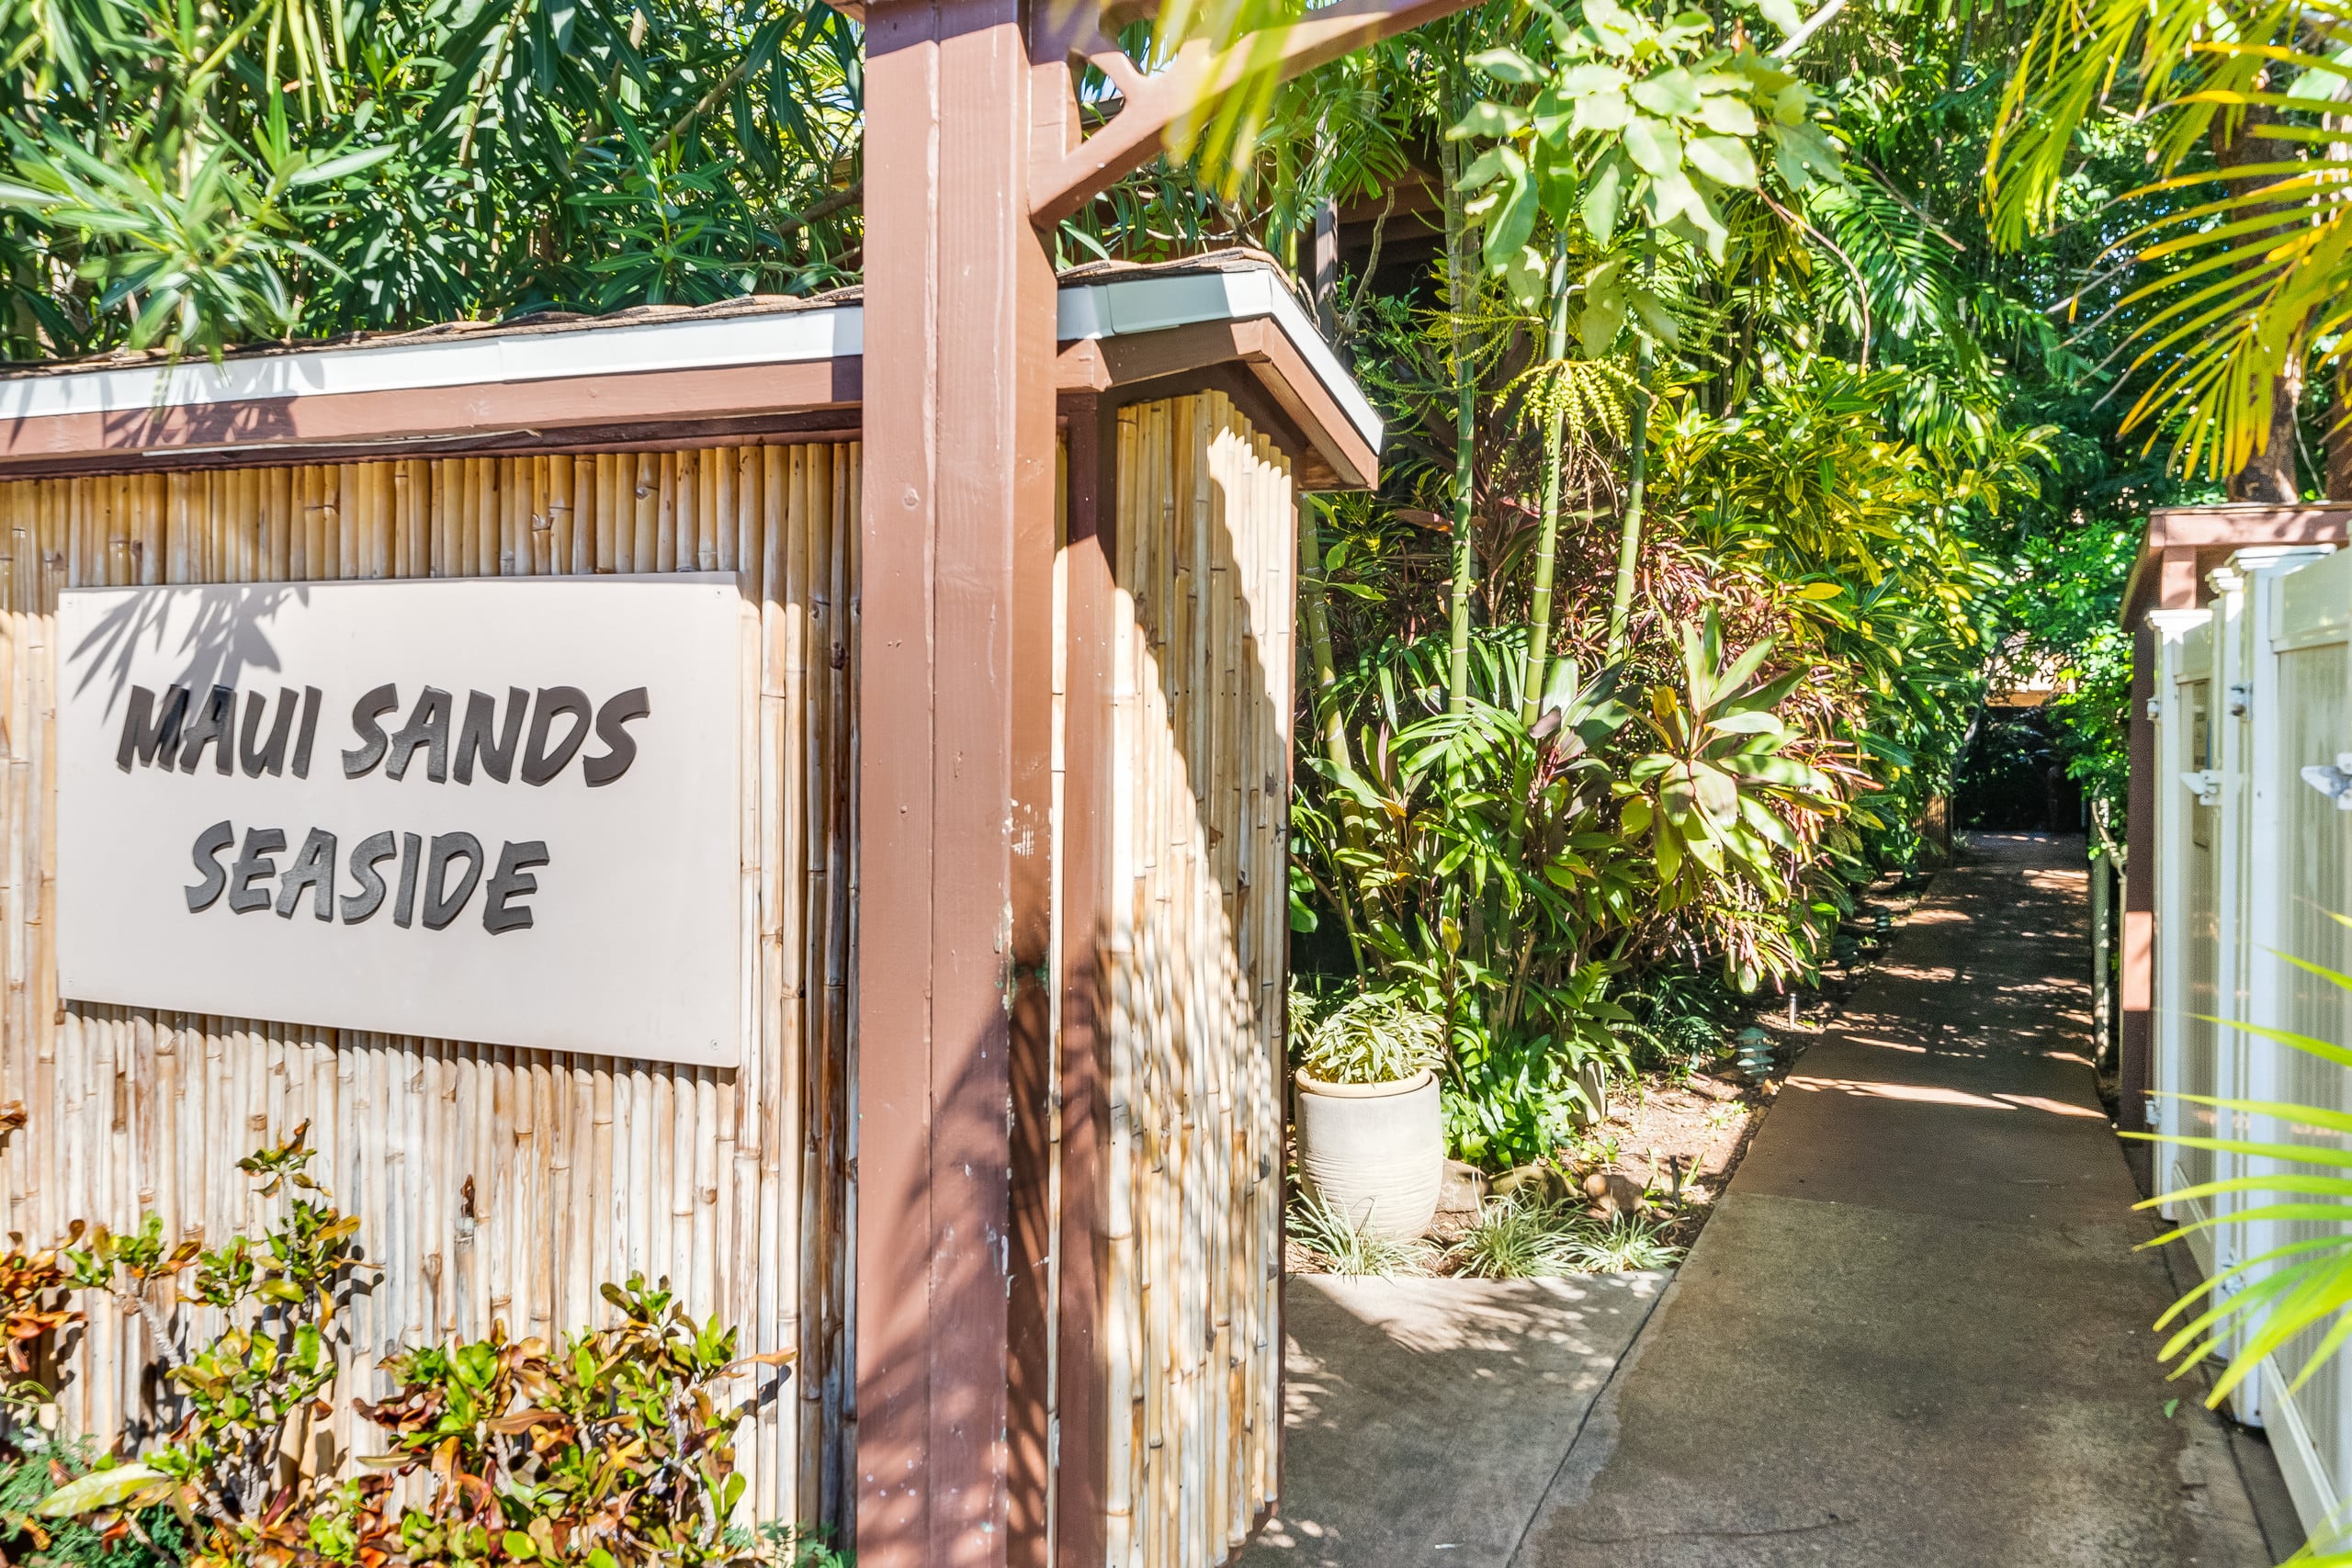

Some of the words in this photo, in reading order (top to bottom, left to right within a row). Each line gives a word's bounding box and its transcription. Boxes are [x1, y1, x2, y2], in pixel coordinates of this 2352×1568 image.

[116, 684, 322, 780] MAUI
[341, 682, 651, 788] SANDS
[184, 819, 550, 936] SEASIDE
